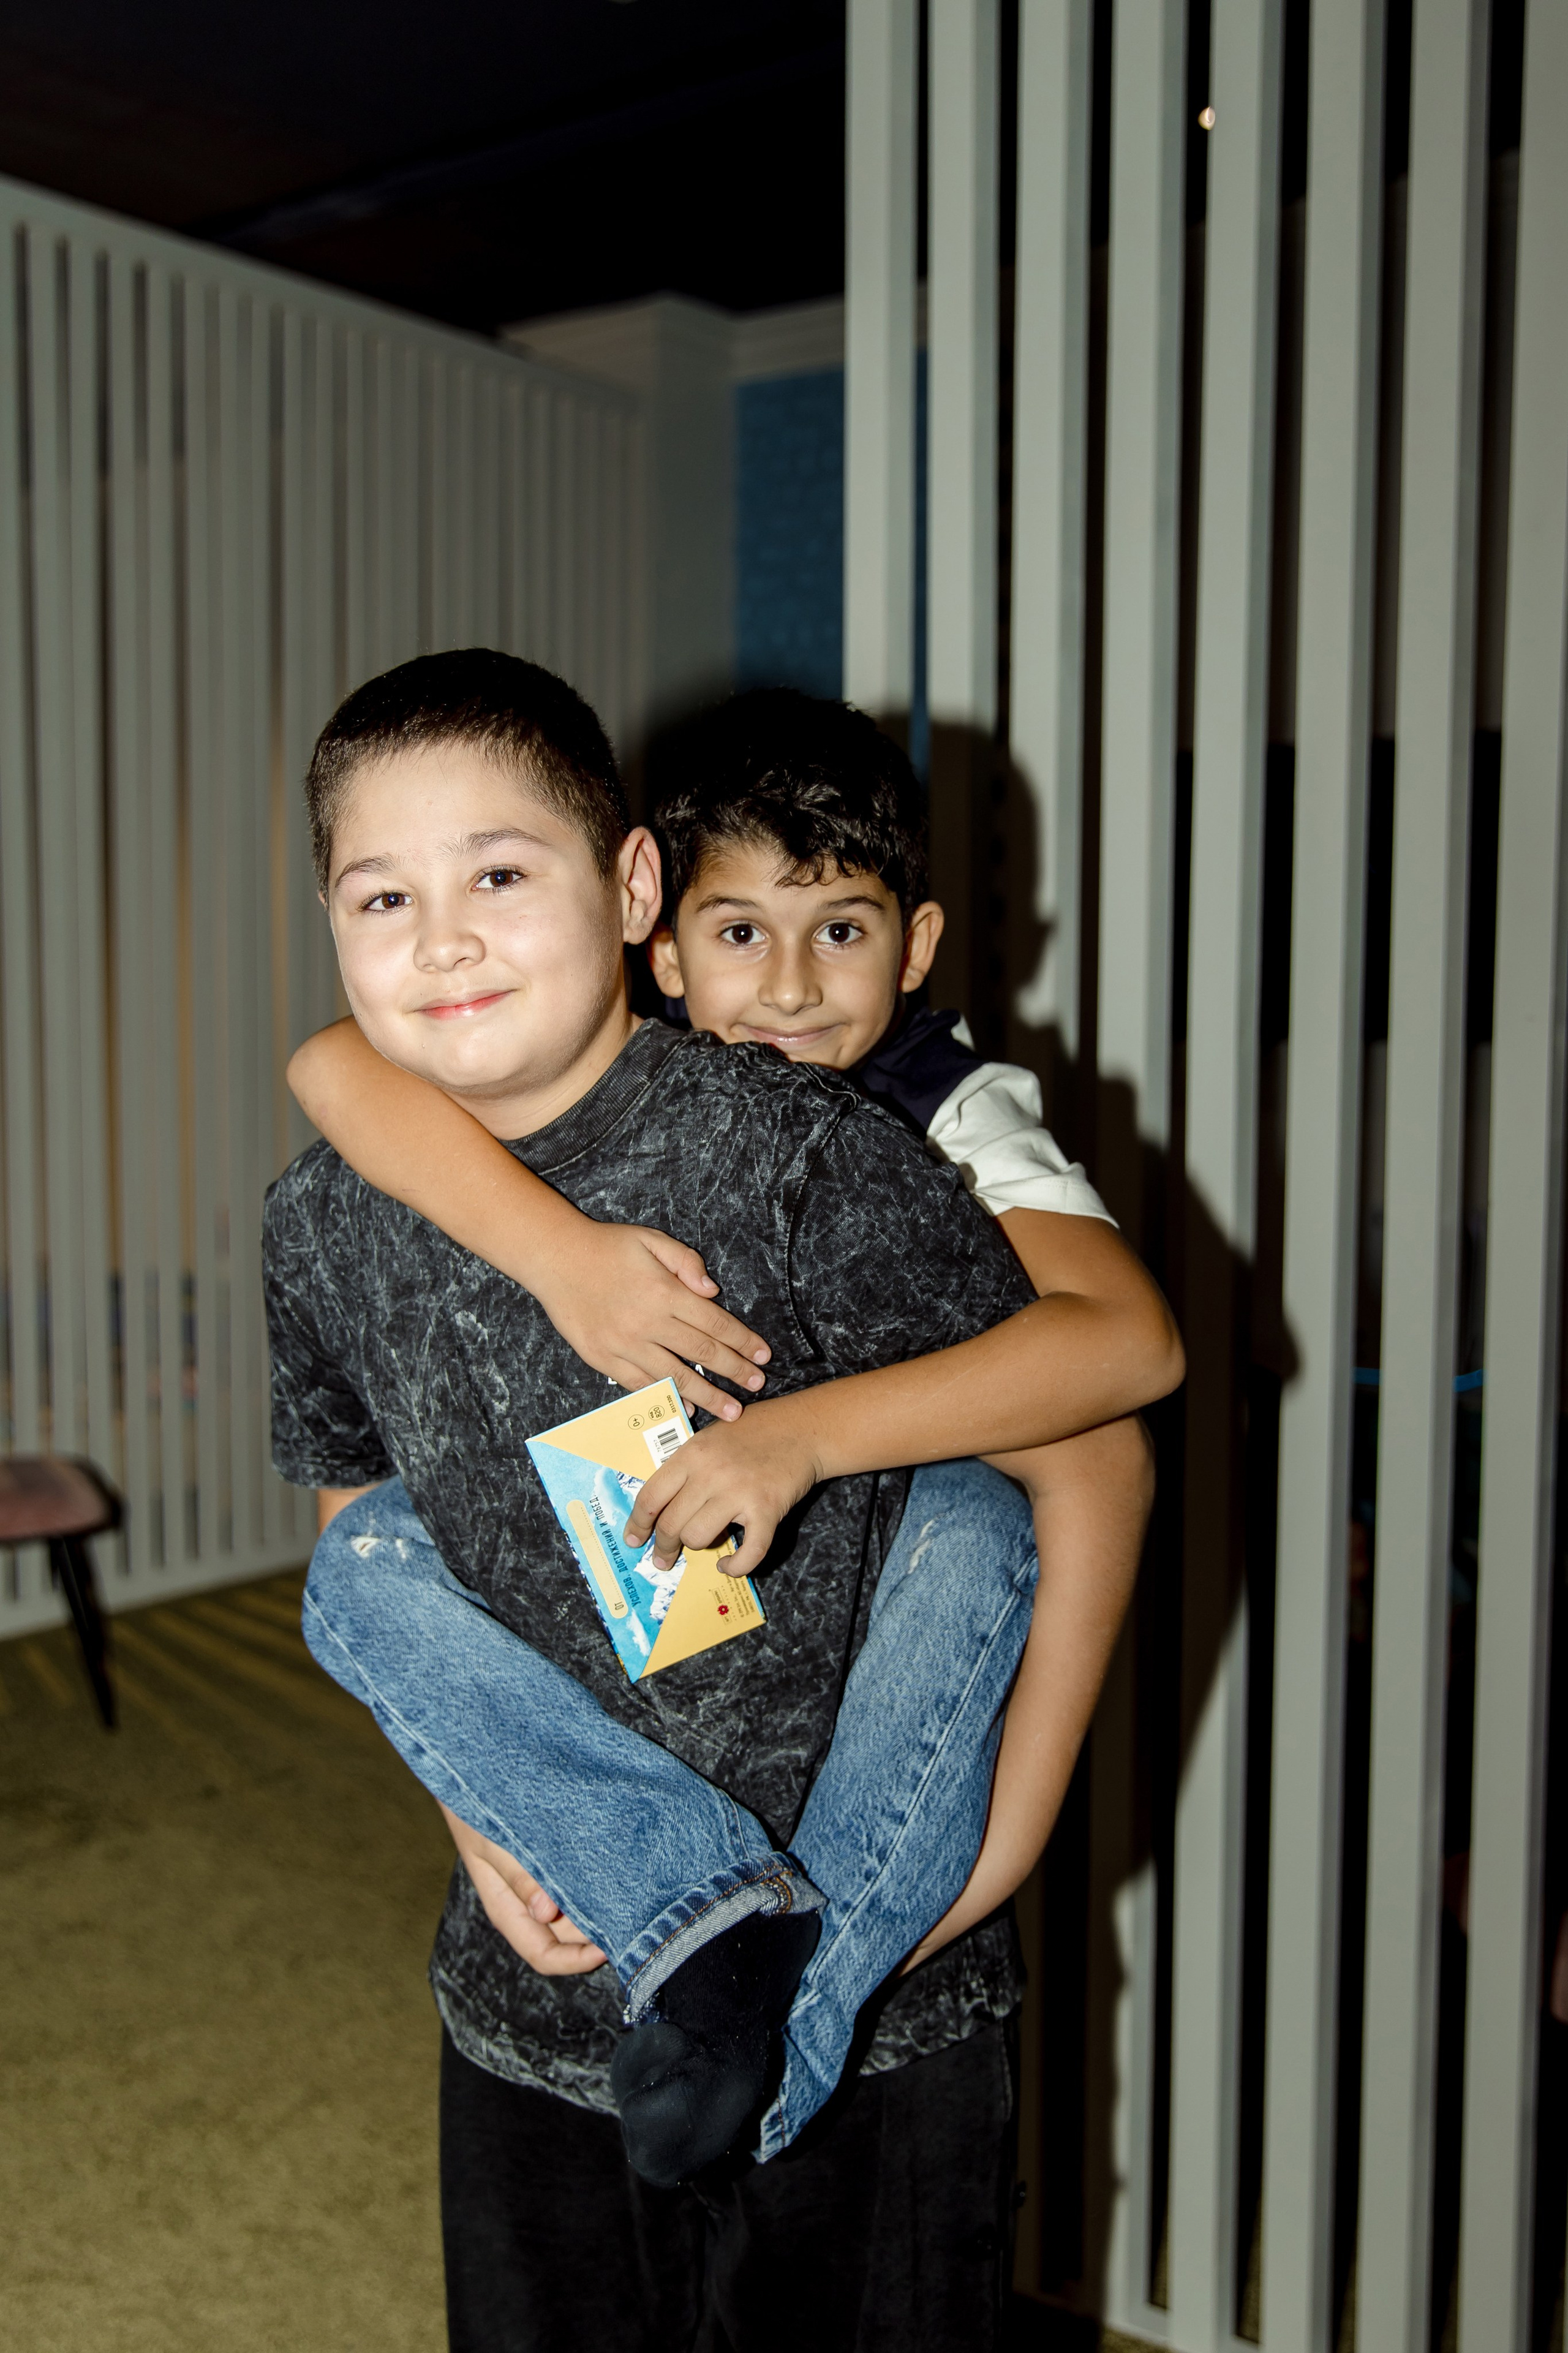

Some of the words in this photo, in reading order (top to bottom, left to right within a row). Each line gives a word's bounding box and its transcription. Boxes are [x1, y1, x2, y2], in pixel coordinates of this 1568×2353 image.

[666, 1394, 677, 1413] 0317.100
[653, 1406, 662, 1418] 820
[631, 1417, 640, 1427] 0+
